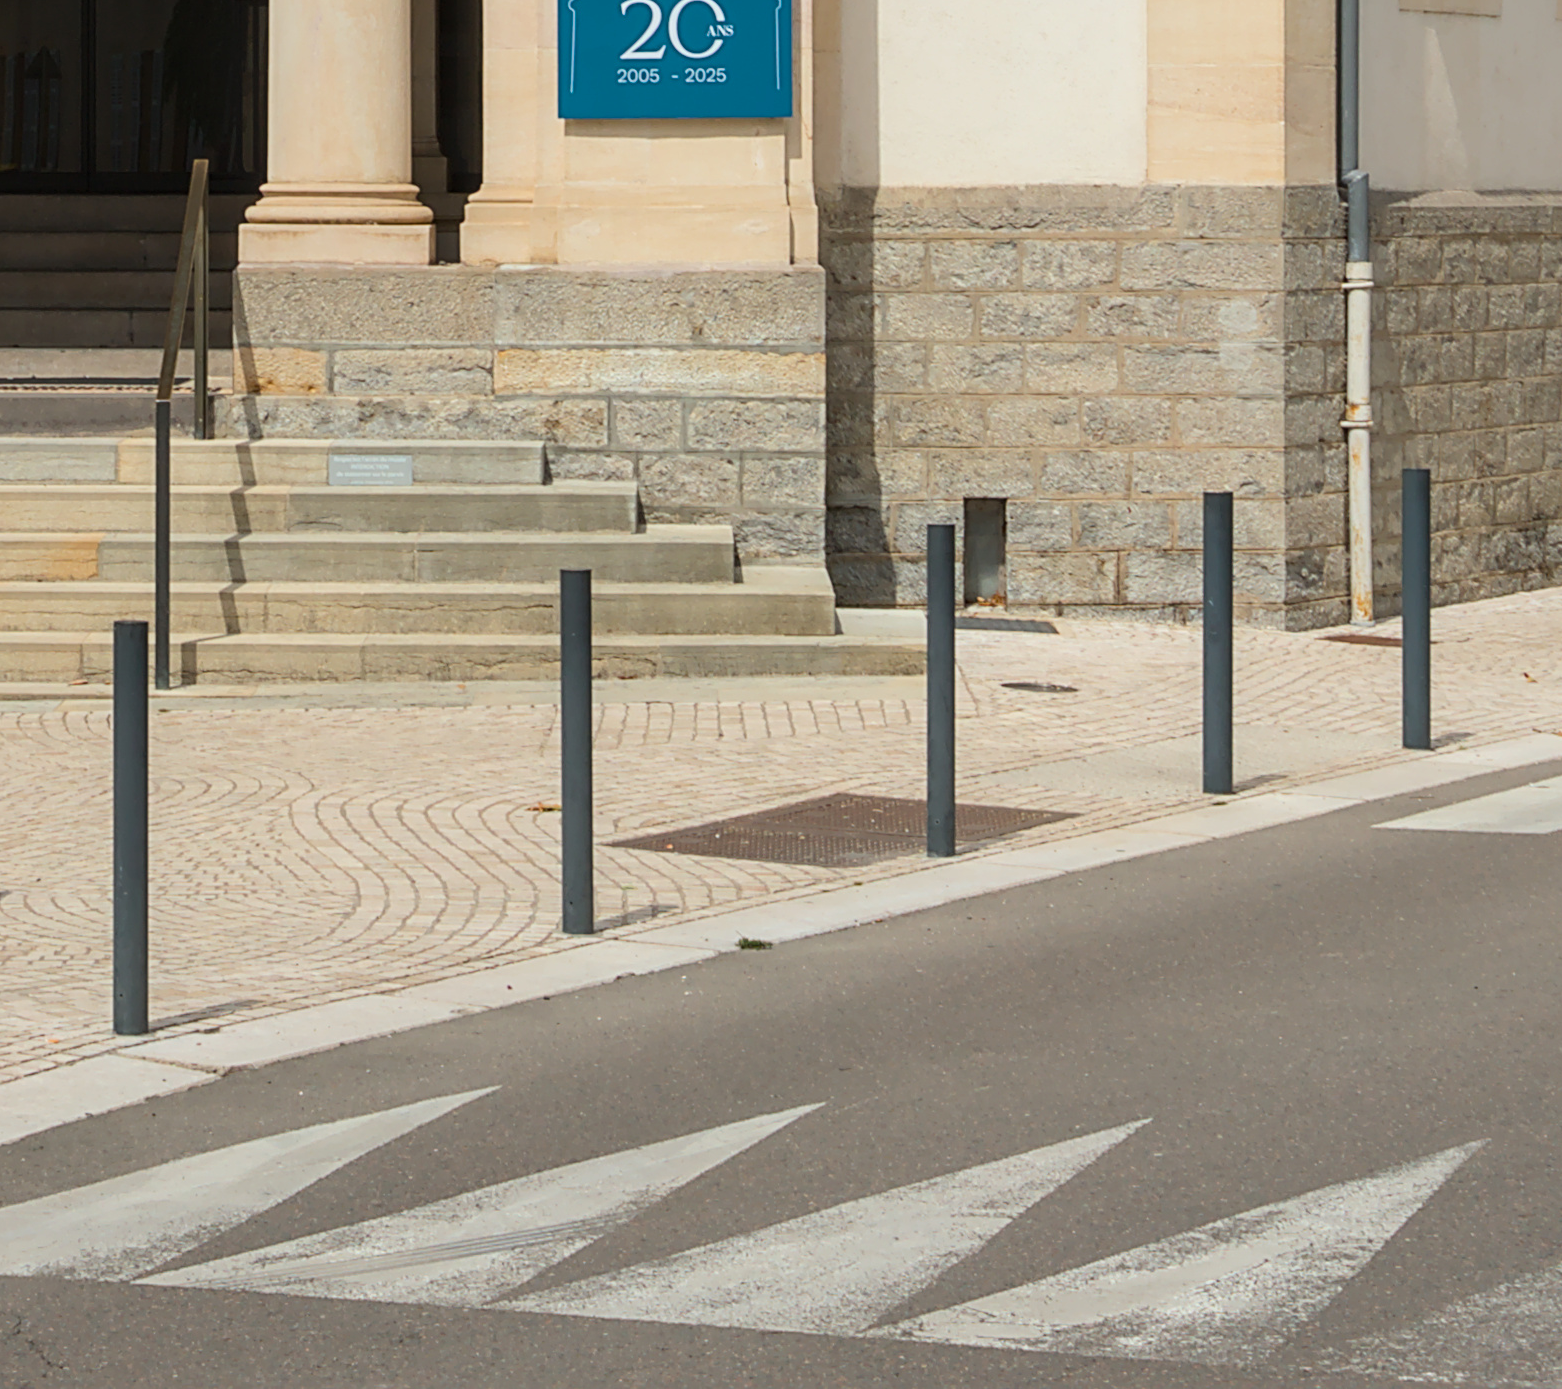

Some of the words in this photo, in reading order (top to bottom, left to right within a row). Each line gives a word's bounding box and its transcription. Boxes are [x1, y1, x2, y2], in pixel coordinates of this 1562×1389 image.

[706, 24, 734, 37] ANS
[617, 68, 660, 83] 2005
[684, 67, 727, 83] 2025
